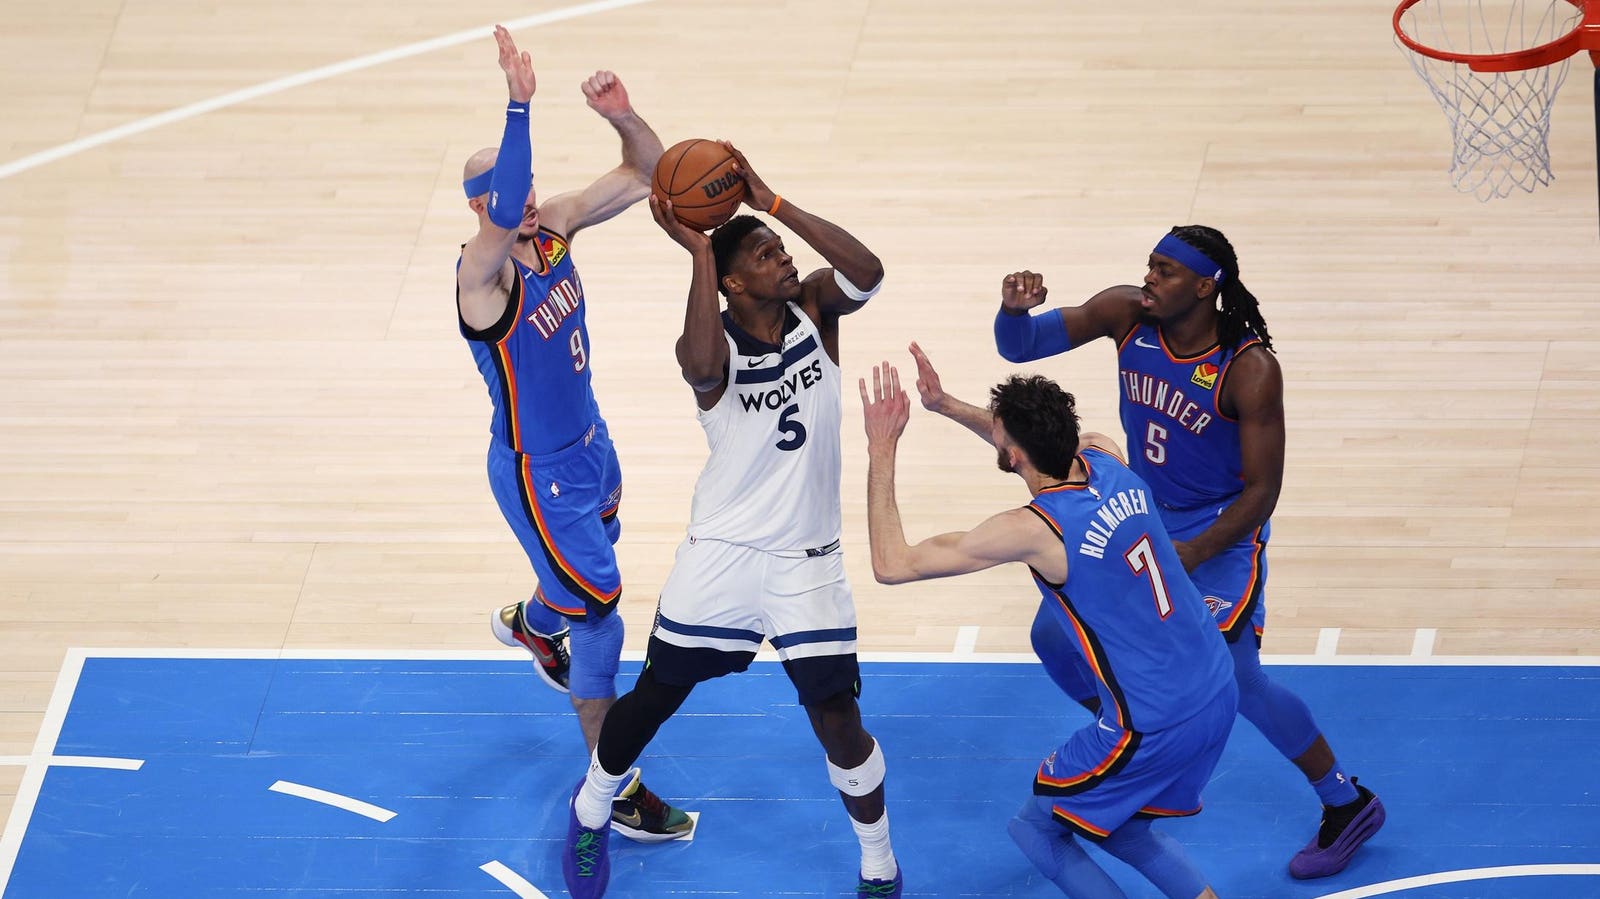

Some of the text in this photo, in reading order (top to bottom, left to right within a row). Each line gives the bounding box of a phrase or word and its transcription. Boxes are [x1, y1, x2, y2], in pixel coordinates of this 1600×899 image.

[569, 328, 586, 373] 9
[739, 359, 822, 413] WOLVES
[1120, 370, 1212, 435] THUNDER
[775, 403, 807, 451] 5
[1145, 421, 1168, 465] 5
[1079, 488, 1149, 559] HOLMGREN
[1123, 533, 1174, 621] 7
